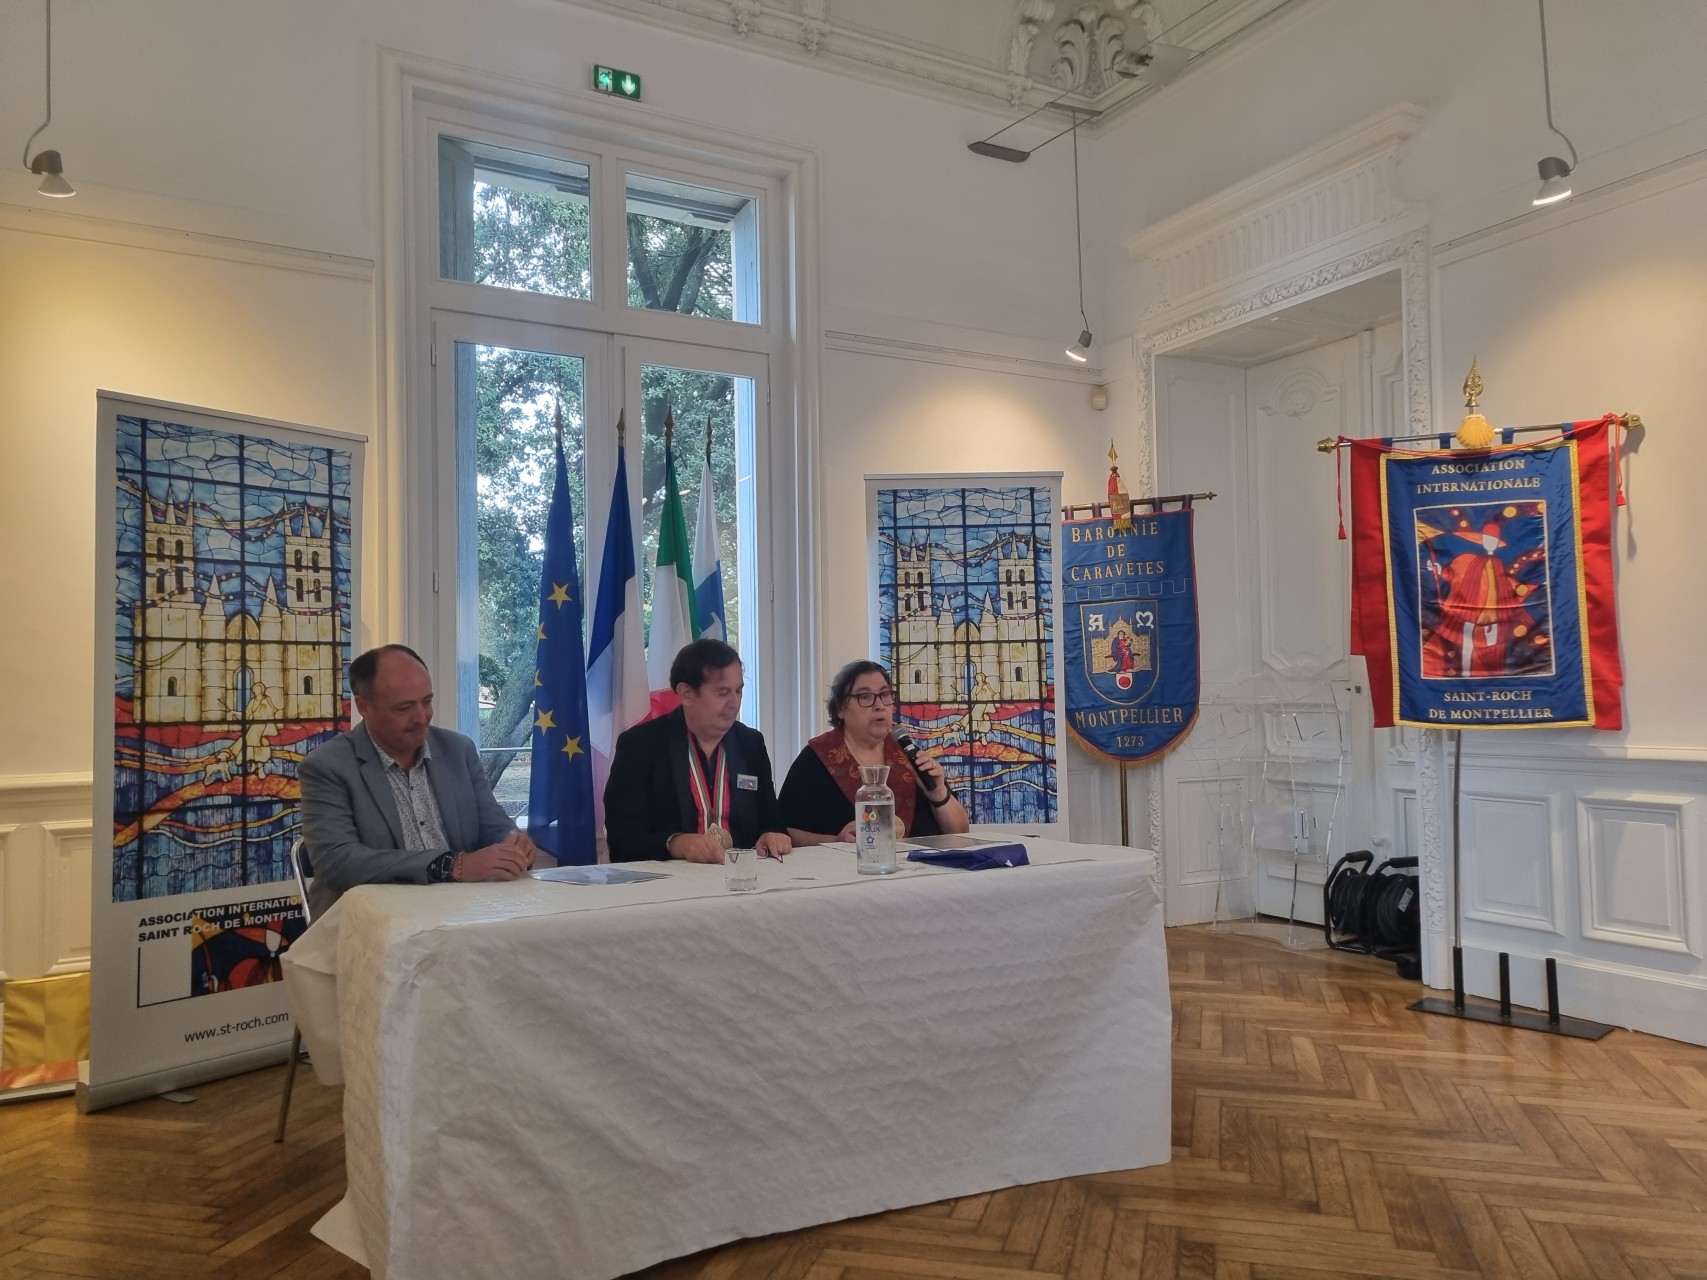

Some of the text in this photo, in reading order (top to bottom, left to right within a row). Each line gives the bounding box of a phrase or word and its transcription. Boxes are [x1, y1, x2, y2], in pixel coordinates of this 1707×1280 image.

[1432, 460, 1525, 475] ASSOCIATION
[1417, 477, 1541, 494] INTERNATIONALE
[1106, 544, 1126, 558] DE
[1071, 561, 1164, 581] CARAVETES
[1444, 690, 1532, 702] SAINT-ROCH
[1075, 706, 1183, 729] MONTPELLIER
[1429, 708, 1553, 720] DE MONTPELLIER
[138, 905, 225, 928] ASSOCIATION
[138, 927, 180, 942] SAINT
[183, 921, 220, 935] ROCH
[224, 918, 241, 929] DE
[184, 1012, 289, 1043] www.st-roch.com
